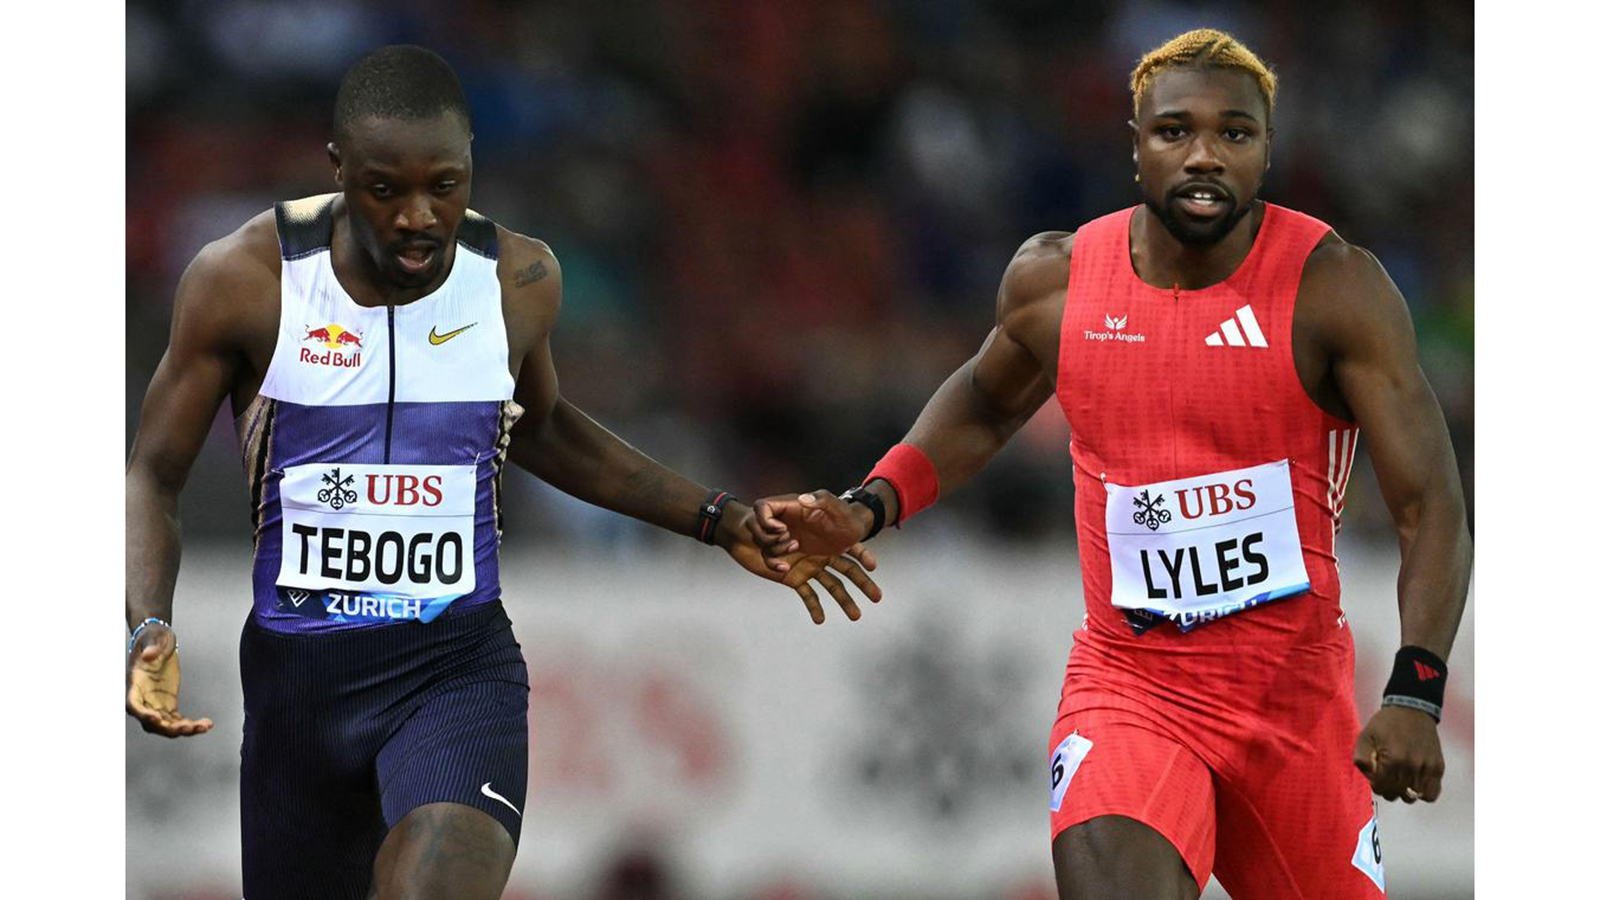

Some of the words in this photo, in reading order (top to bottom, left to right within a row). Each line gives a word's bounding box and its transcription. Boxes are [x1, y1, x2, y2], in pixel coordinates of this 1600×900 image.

[1114, 332, 1146, 343] Angels
[300, 347, 331, 365] Red
[333, 352, 361, 368] Bull
[365, 474, 444, 507] UBS
[1174, 478, 1257, 521] UBS
[292, 522, 464, 585] TEBOGO
[1140, 531, 1270, 600] LYLES
[326, 593, 422, 619] ZURICH
[1052, 752, 1065, 791] 6
[1371, 824, 1382, 865] 6
